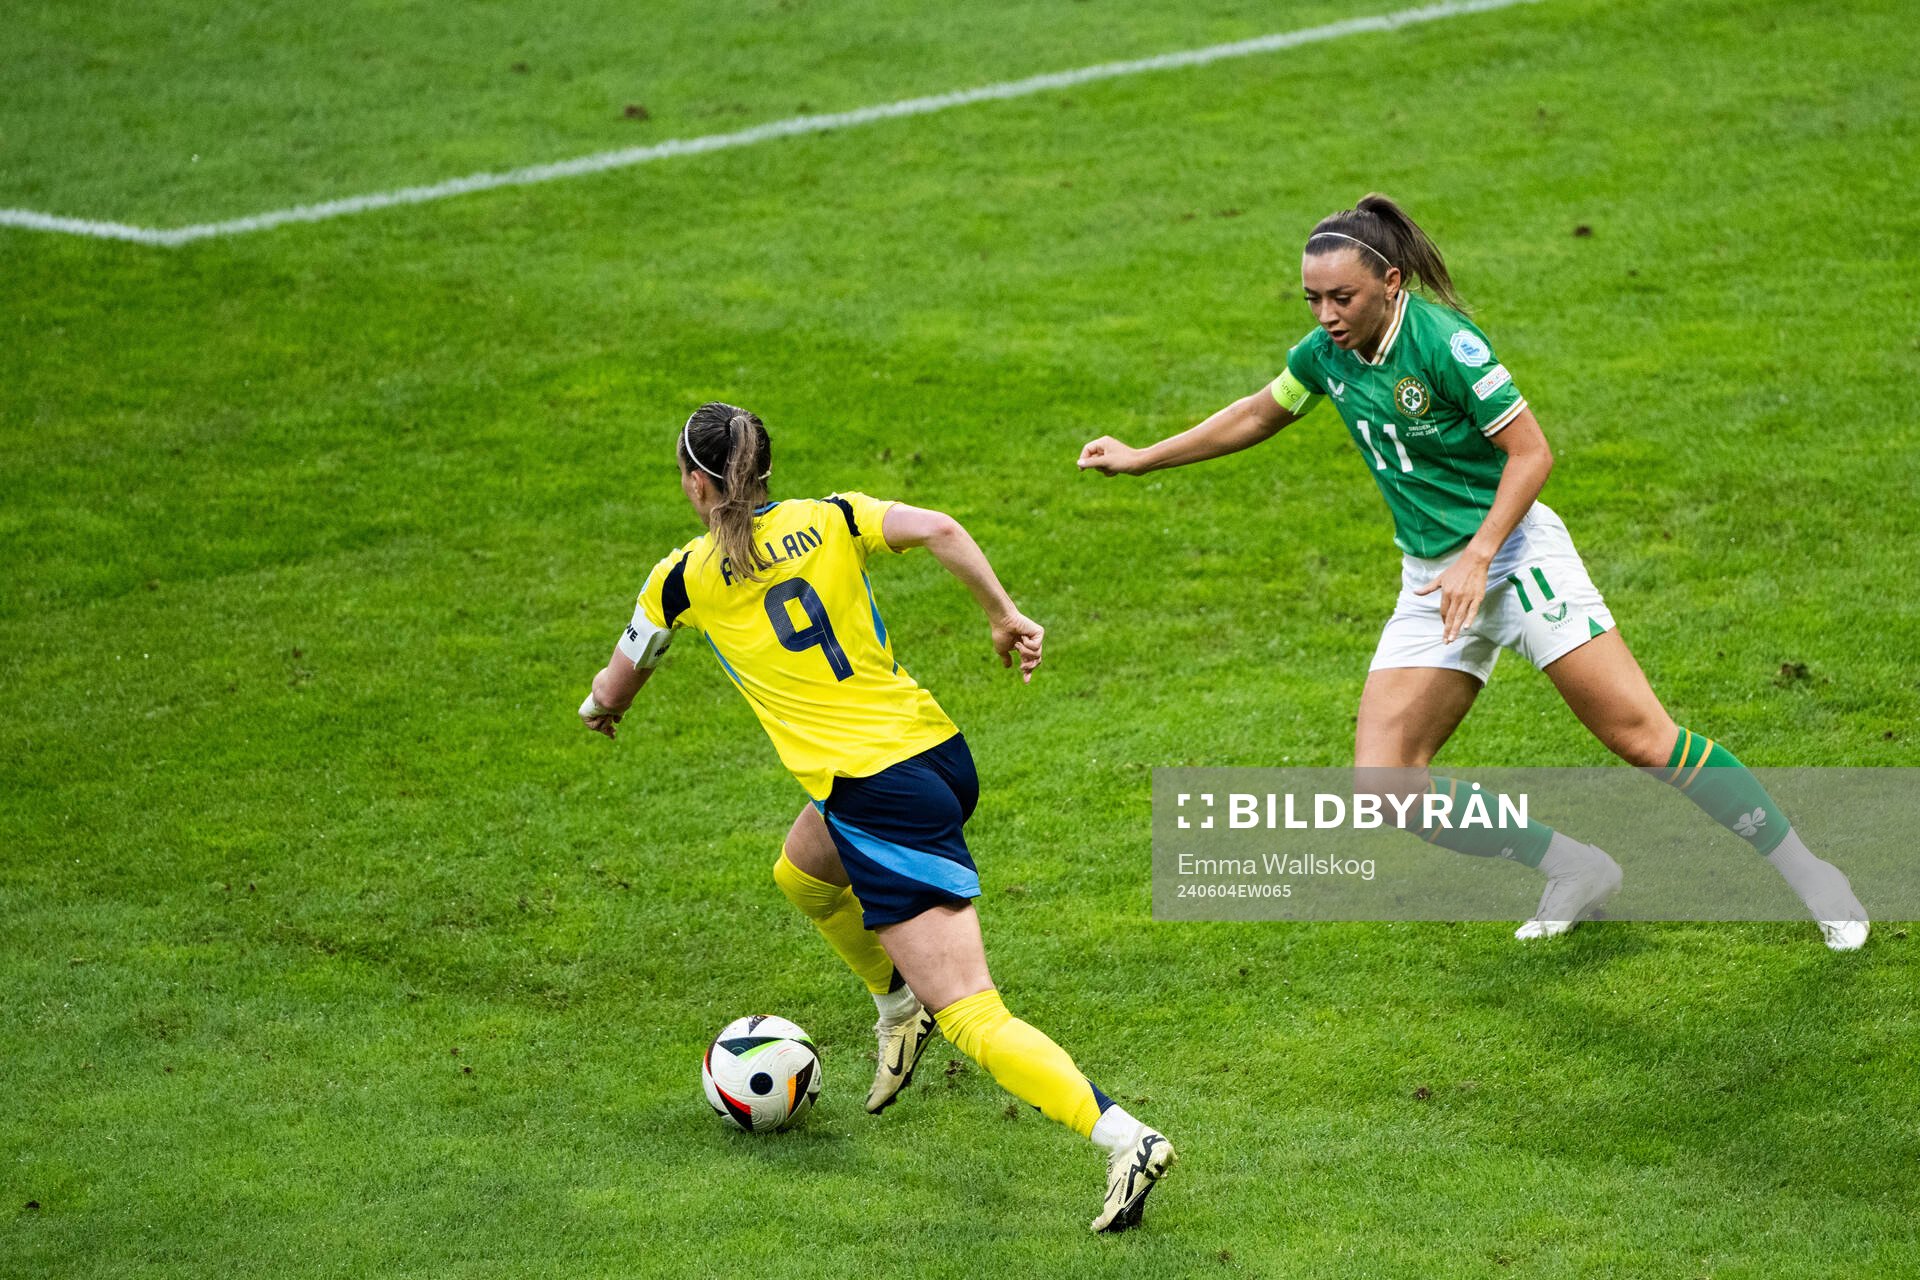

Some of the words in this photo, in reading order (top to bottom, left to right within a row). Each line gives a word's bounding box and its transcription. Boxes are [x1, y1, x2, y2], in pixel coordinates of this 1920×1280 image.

[1357, 420, 1414, 473] 11
[1507, 566, 1555, 613] 11
[764, 577, 854, 682] 9
